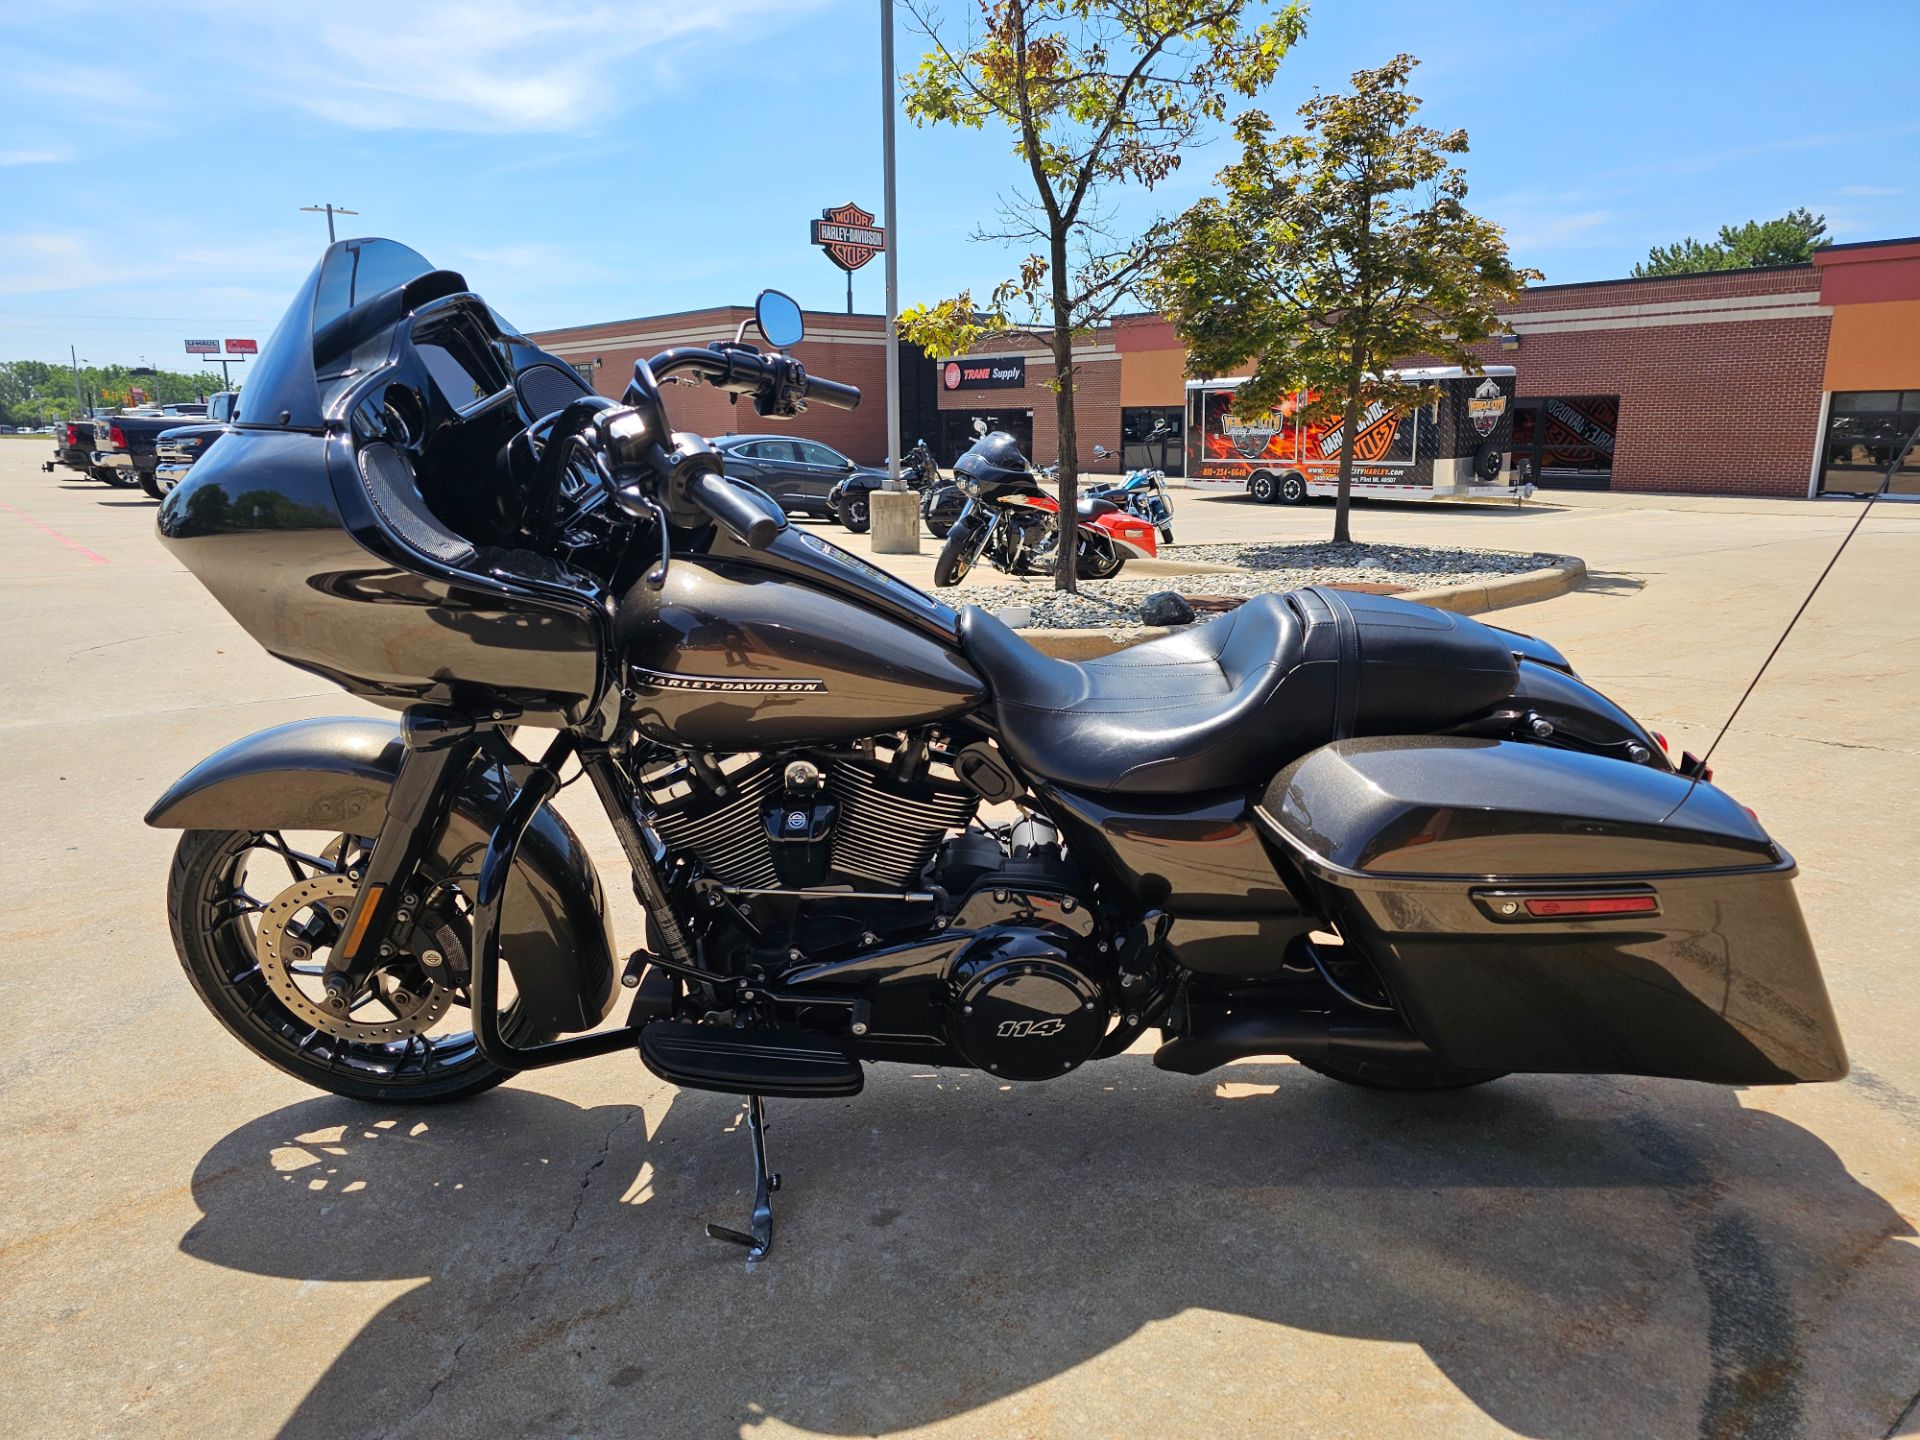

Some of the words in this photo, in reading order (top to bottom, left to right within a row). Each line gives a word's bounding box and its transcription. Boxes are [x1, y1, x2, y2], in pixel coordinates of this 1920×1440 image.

[836, 209, 868, 226] MOTOR
[821, 225, 882, 246] HARLEY-DAVIDSON
[836, 245, 868, 264] CYCLES
[992, 367, 1021, 380] Supply
[1352, 421, 1391, 460] YCLES
[996, 1018, 1066, 1037] 114
